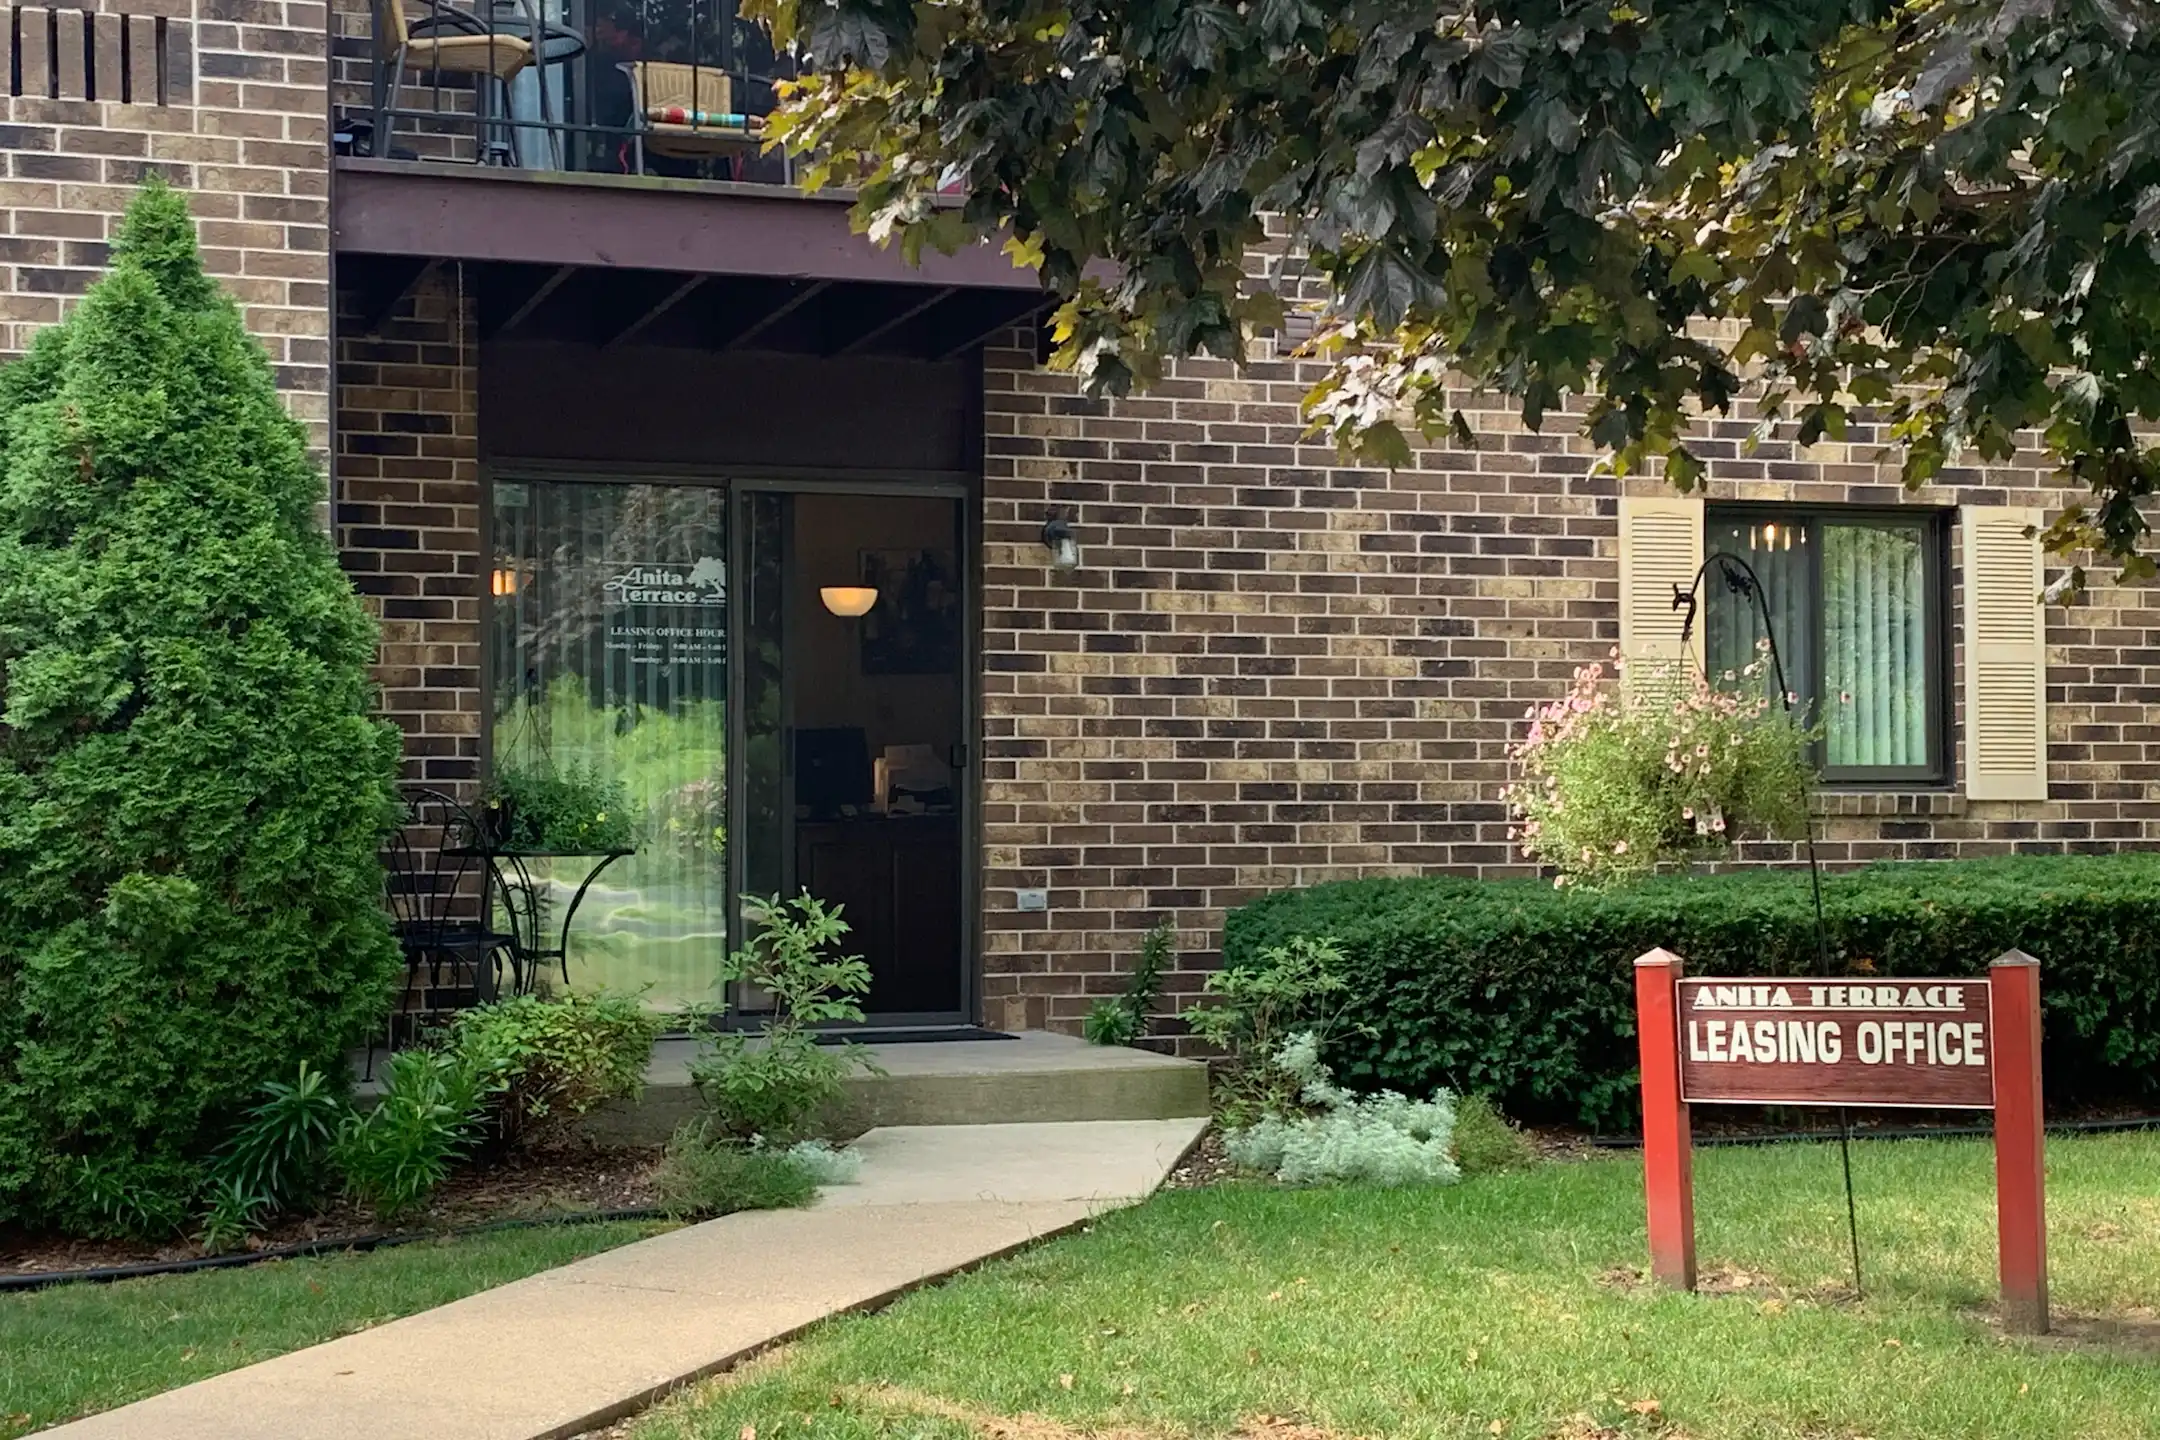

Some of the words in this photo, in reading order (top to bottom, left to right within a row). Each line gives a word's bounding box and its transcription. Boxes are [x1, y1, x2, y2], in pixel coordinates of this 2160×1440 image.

[604, 567, 683, 588] Anita
[618, 586, 697, 603] Terrace
[610, 626, 654, 636] LEASING
[656, 627, 694, 637] OFFICE
[1693, 986, 1793, 1007] ANITA
[1807, 986, 1966, 1008] TERRACE
[1688, 1020, 1842, 1064] LEASING
[1856, 1021, 1986, 1066] OFFICE
